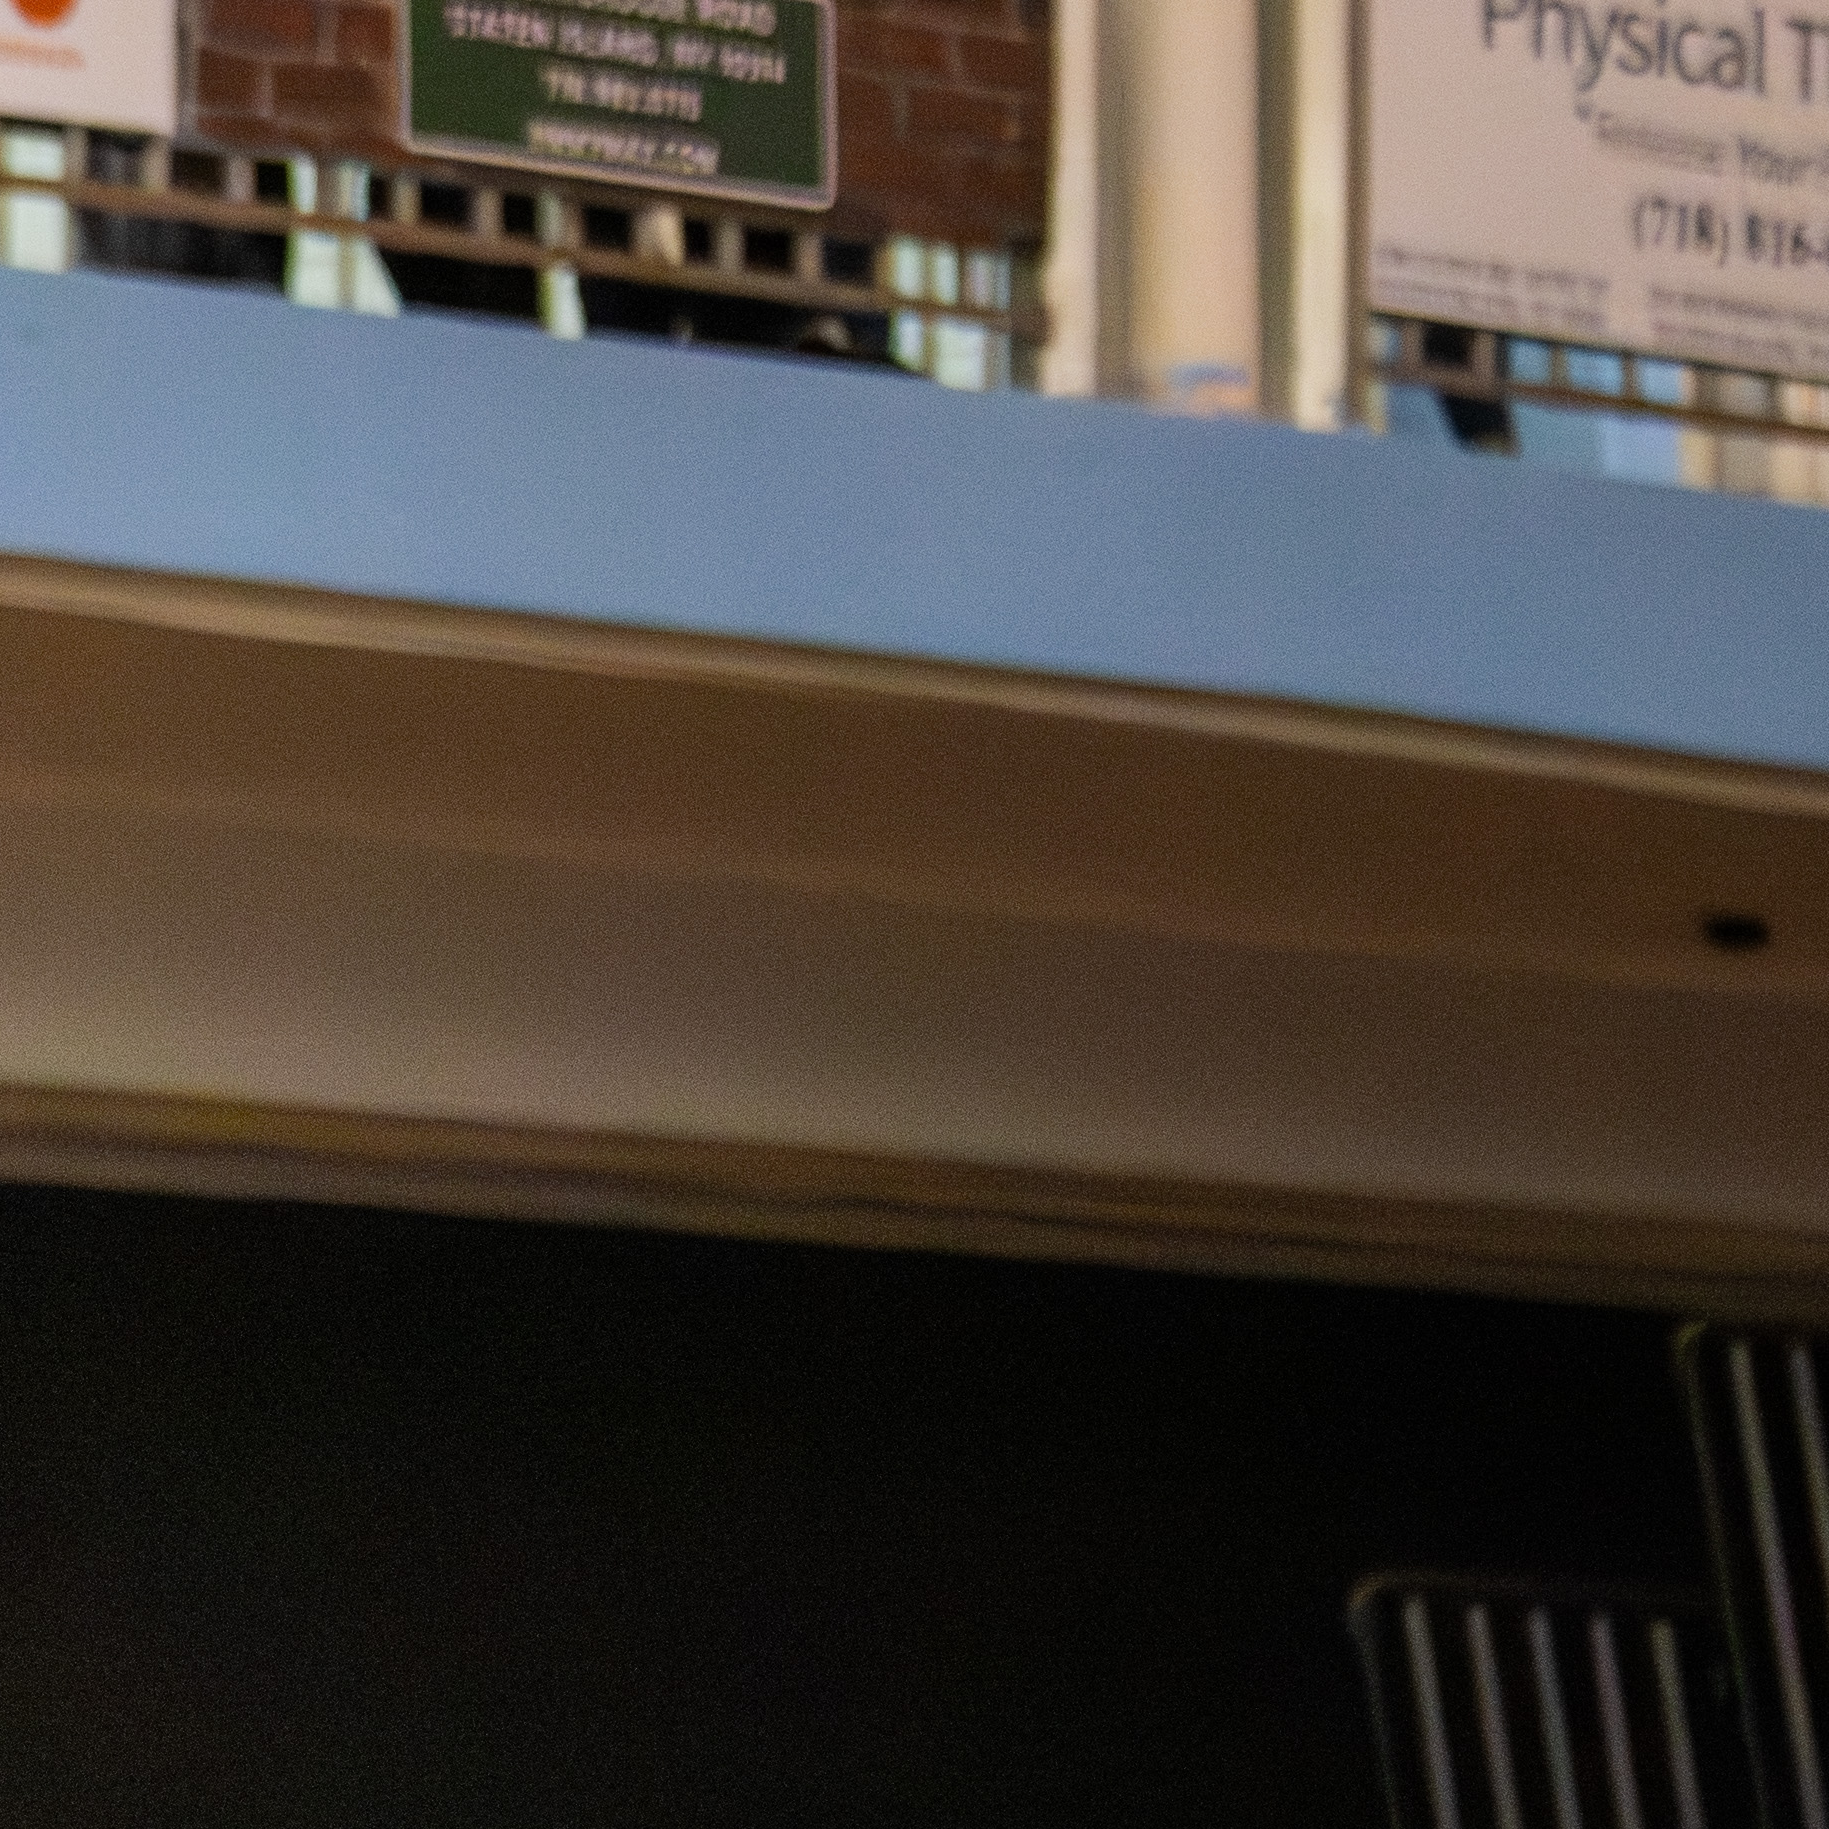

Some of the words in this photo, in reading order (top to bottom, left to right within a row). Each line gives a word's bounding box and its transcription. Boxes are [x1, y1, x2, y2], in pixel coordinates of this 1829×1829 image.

[444, 4, 552, 49] STATEN
[1479, 0, 1766, 94] Physical
[1632, 193, 1731, 268] (718)
